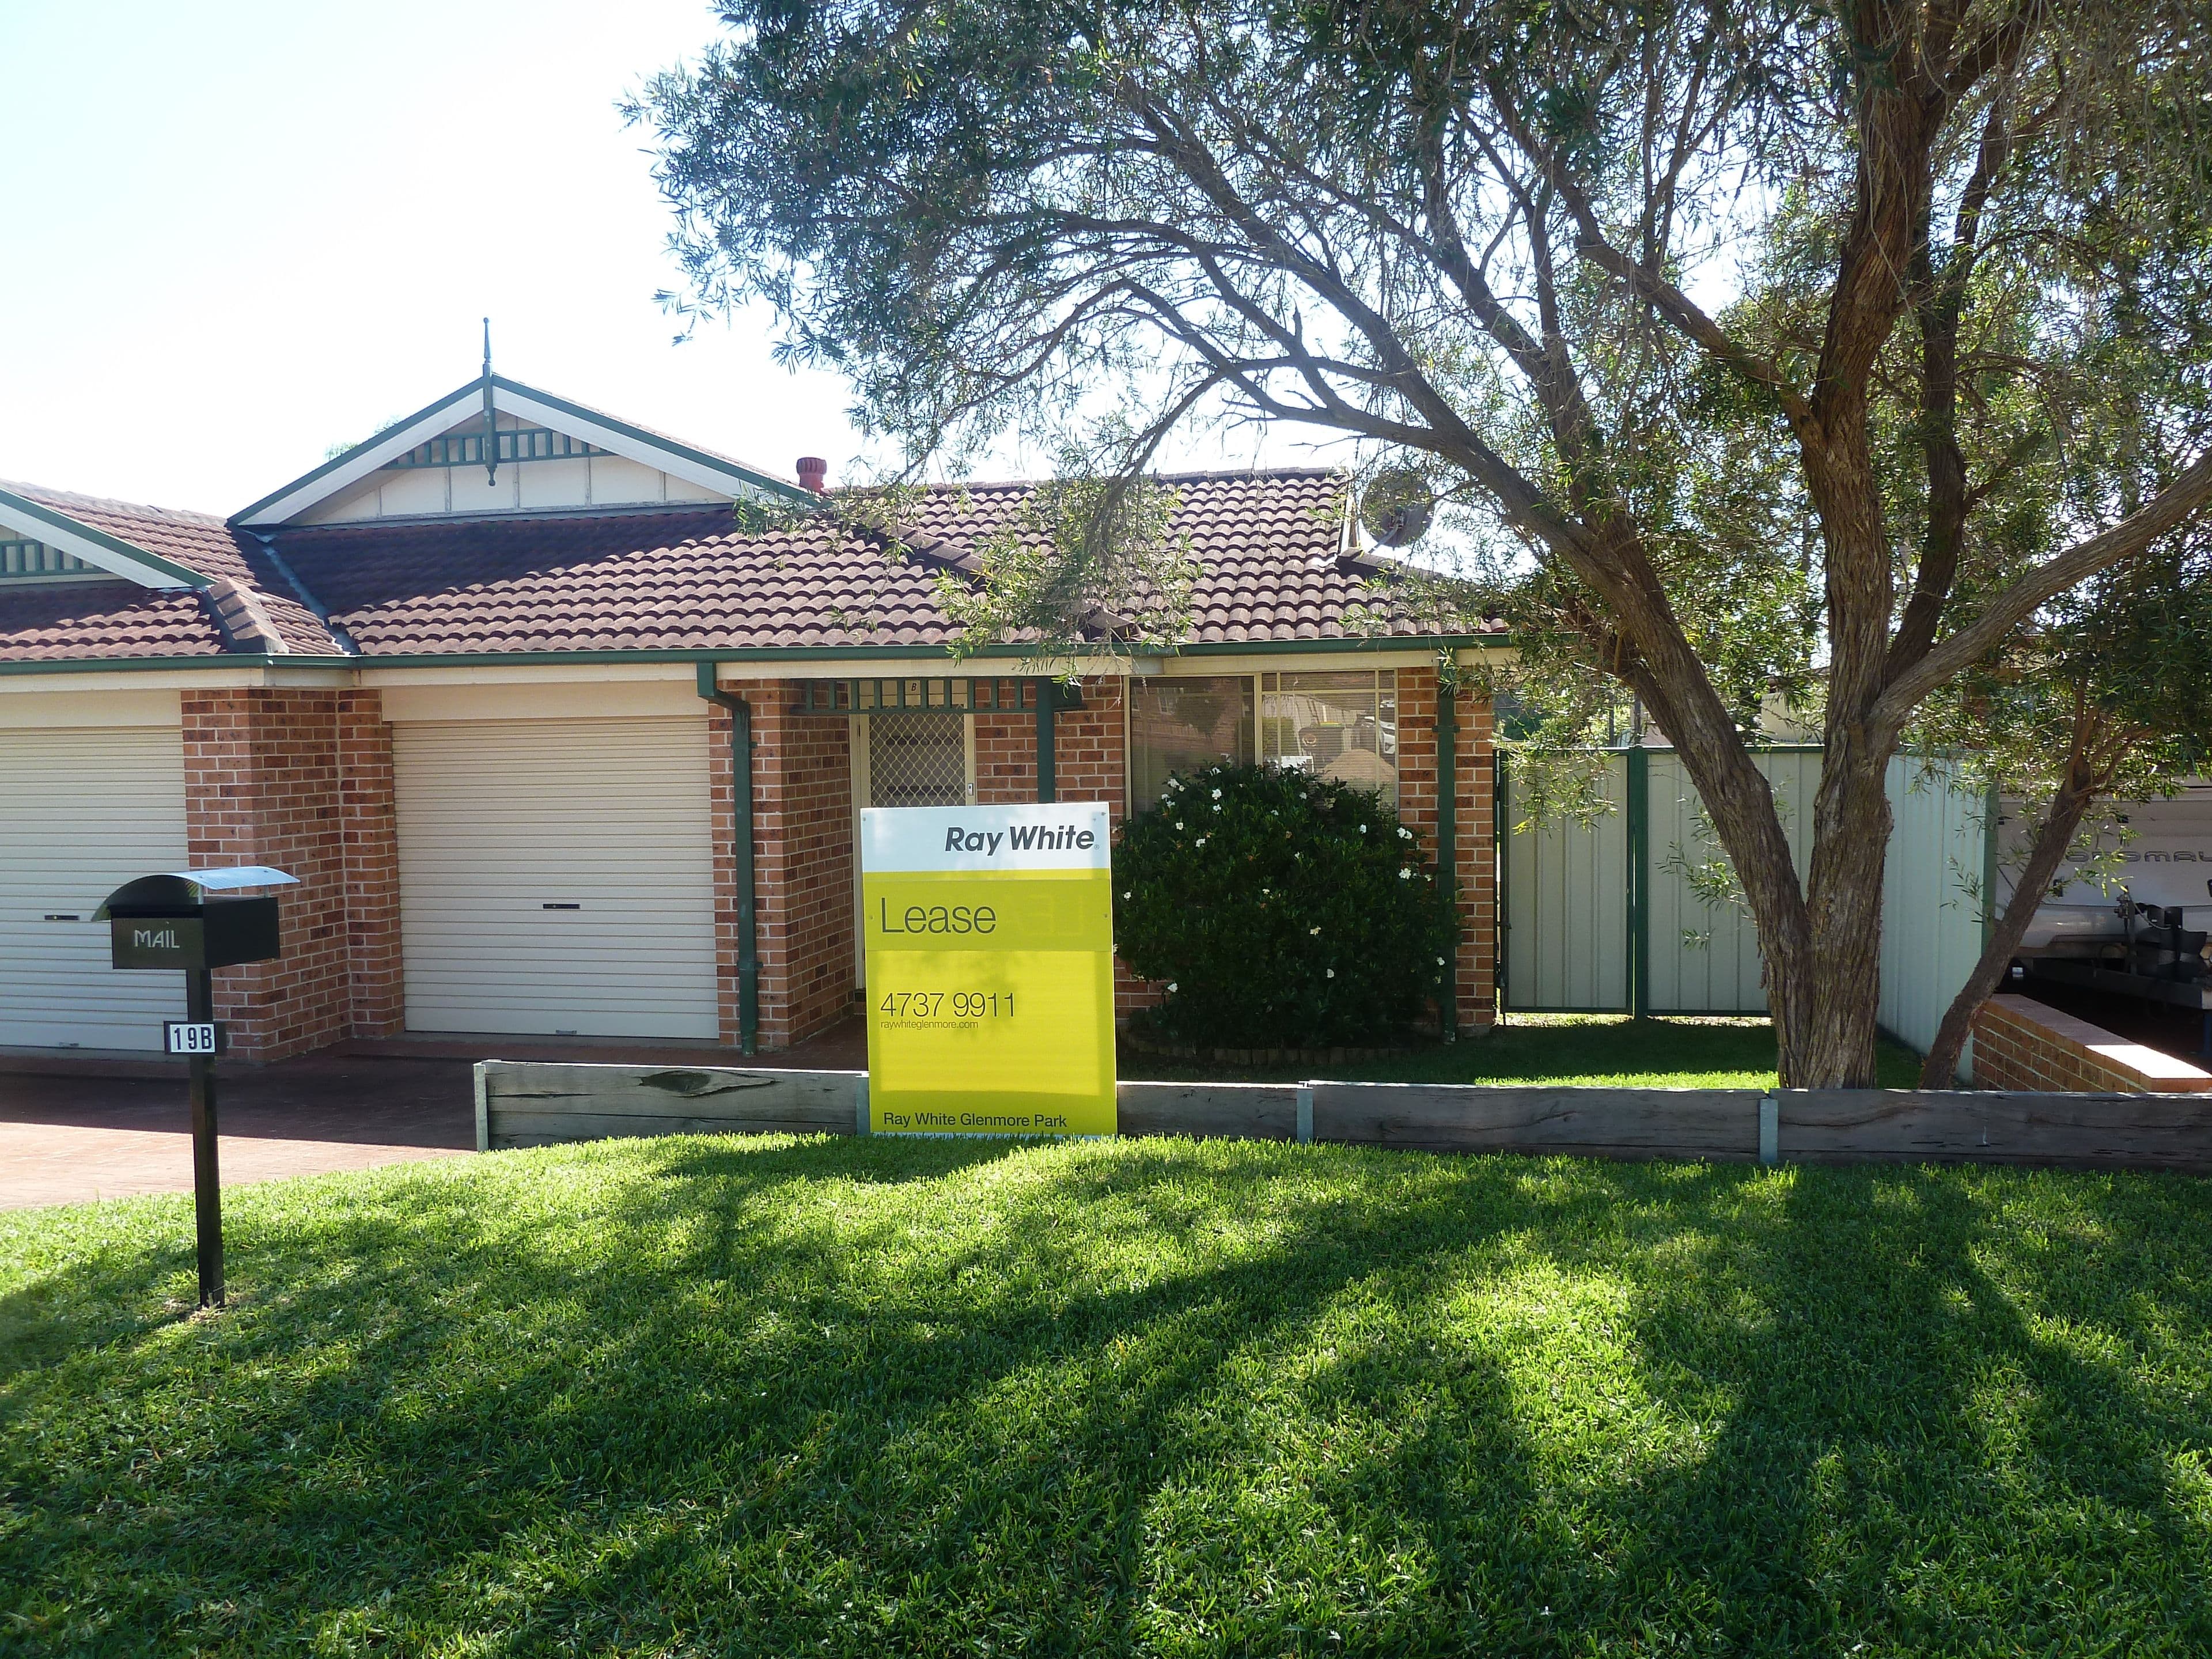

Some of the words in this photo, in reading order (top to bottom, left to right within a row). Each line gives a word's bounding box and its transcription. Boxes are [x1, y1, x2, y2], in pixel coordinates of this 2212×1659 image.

[945, 827, 1003, 856] Ray
[1009, 825, 1094, 850] White
[881, 897, 997, 934] Lease
[134, 930, 180, 949] MAIL
[880, 992, 945, 1017] 4737
[953, 992, 1014, 1017] 9911
[880, 1020, 979, 1029] raywhiteglenmore.com
[174, 1027, 213, 1051] 19B
[884, 1112, 911, 1127] Ray
[914, 1113, 956, 1125] White
[960, 1113, 1030, 1127] Glenmore
[1034, 1115, 1067, 1127] Park
